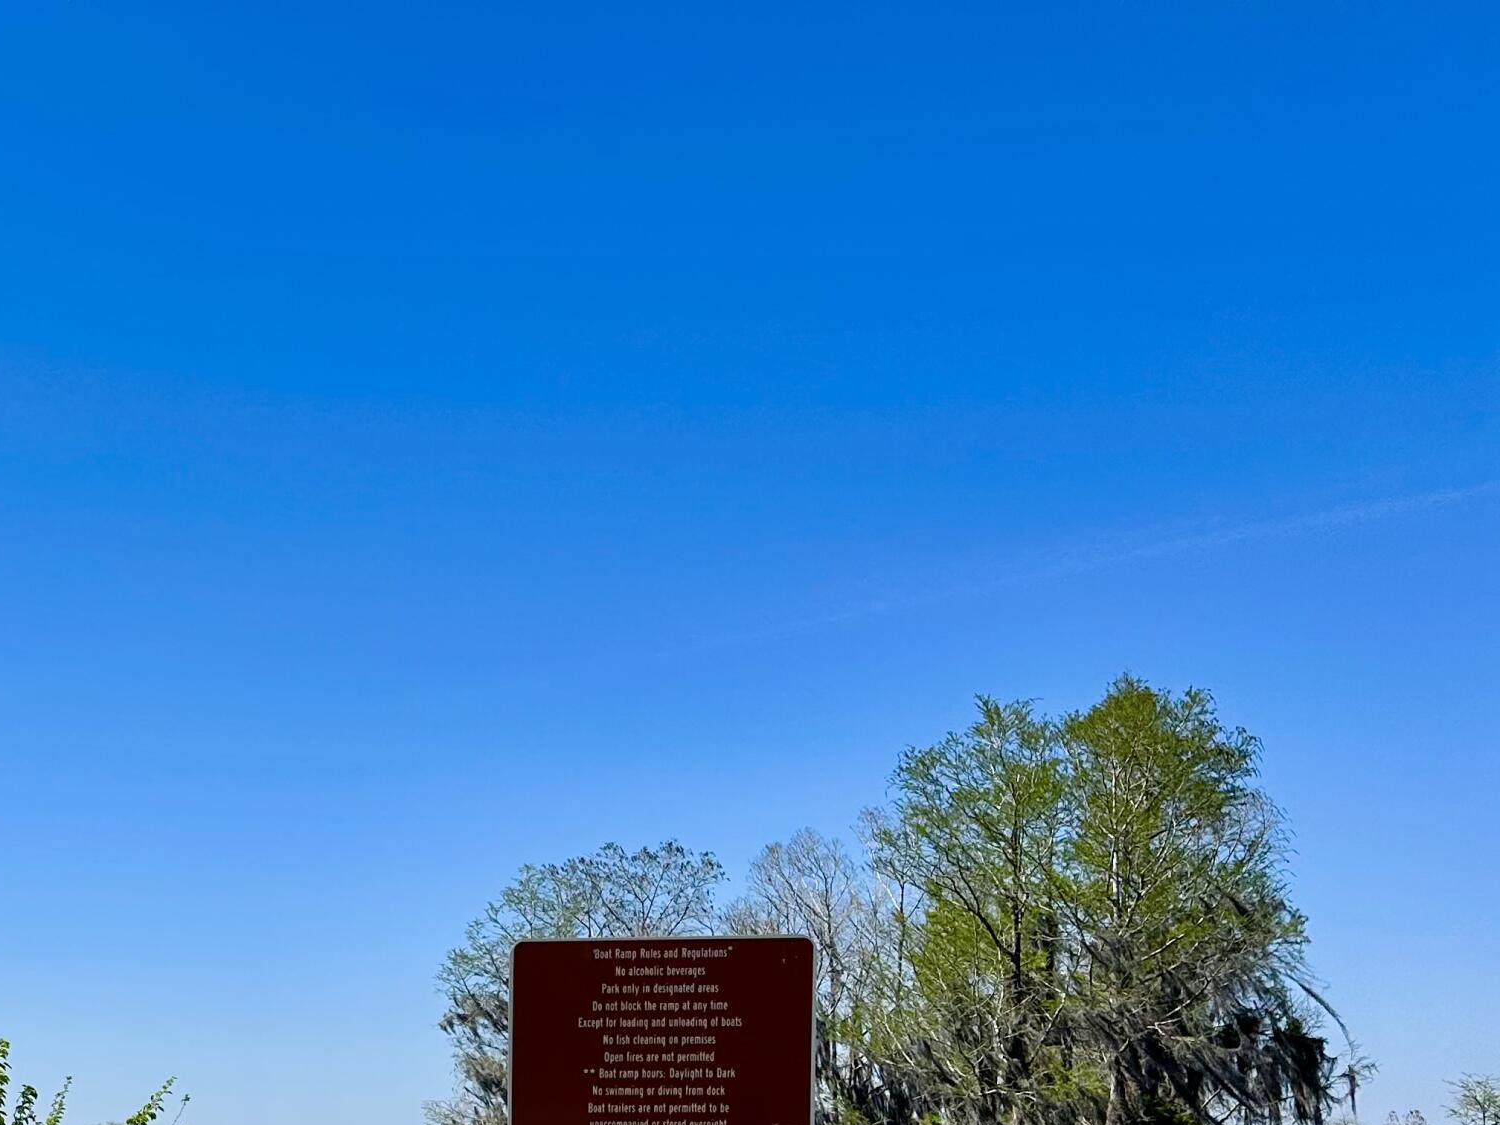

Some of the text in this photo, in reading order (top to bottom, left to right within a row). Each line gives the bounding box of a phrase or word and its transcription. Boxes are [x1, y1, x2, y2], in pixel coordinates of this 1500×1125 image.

[615, 948, 636, 960] Ramp
[640, 948, 661, 959] Rules
[664, 948, 678, 958] and
[616, 965, 705, 978] No alcoholic beverages
[602, 983, 718, 995] Park only in designated areas
[592, 1000, 728, 1012] Do not block the ramp at any time
[578, 1017, 742, 1029] Except for loading and unloading of boats
[603, 1034, 716, 1046] No fish cleaning on premises
[604, 1051, 715, 1063] Open fires are not permitted
[599, 1068, 616, 1078] Boat
[619, 1071, 638, 1080] ramp
[670, 1068, 702, 1080] Daylight
[706, 1068, 713, 1078] to
[717, 1068, 735, 1078] Dark
[593, 1086, 602, 1096] No
[605, 1086, 643, 1098] swimming
[658, 1086, 682, 1098] diving
[686, 1086, 703, 1095] from
[707, 1086, 725, 1095] dock
[588, 1102, 729, 1114] Boat trailers are not permitted to be
